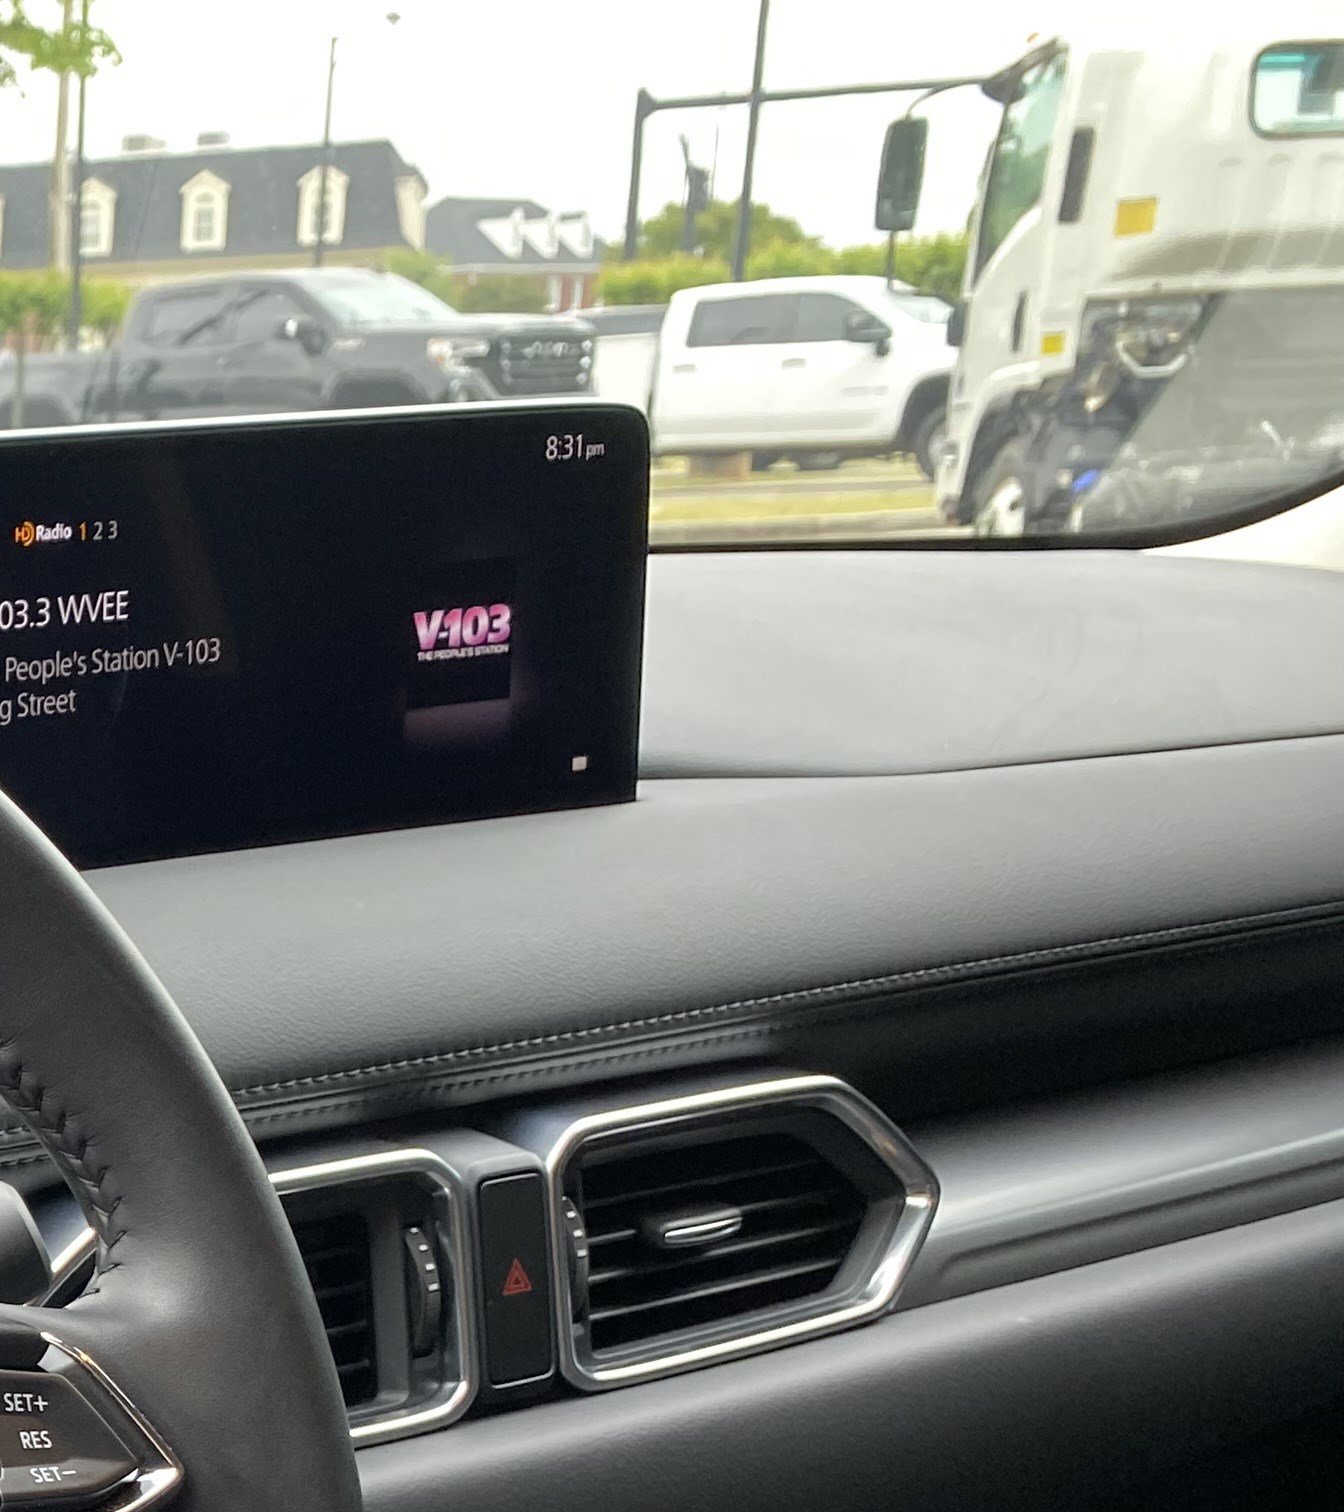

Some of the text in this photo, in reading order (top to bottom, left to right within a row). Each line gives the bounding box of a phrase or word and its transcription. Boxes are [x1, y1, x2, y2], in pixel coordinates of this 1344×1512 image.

[545, 434, 605, 461] 8:31 pm
[36, 523, 73, 542] Radio
[79, 521, 89, 541] 1
[93, 521, 104, 541] 2
[108, 519, 119, 540] 3
[57, 589, 130, 625] WVEE
[413, 603, 511, 651] V-103
[5, 651, 87, 684] People's
[91, 645, 160, 674] Station
[162, 638, 221, 667] V-103
[16, 690, 77, 718] Street
[3, 1392, 49, 1413] SET+
[19, 1430, 53, 1450] RES
